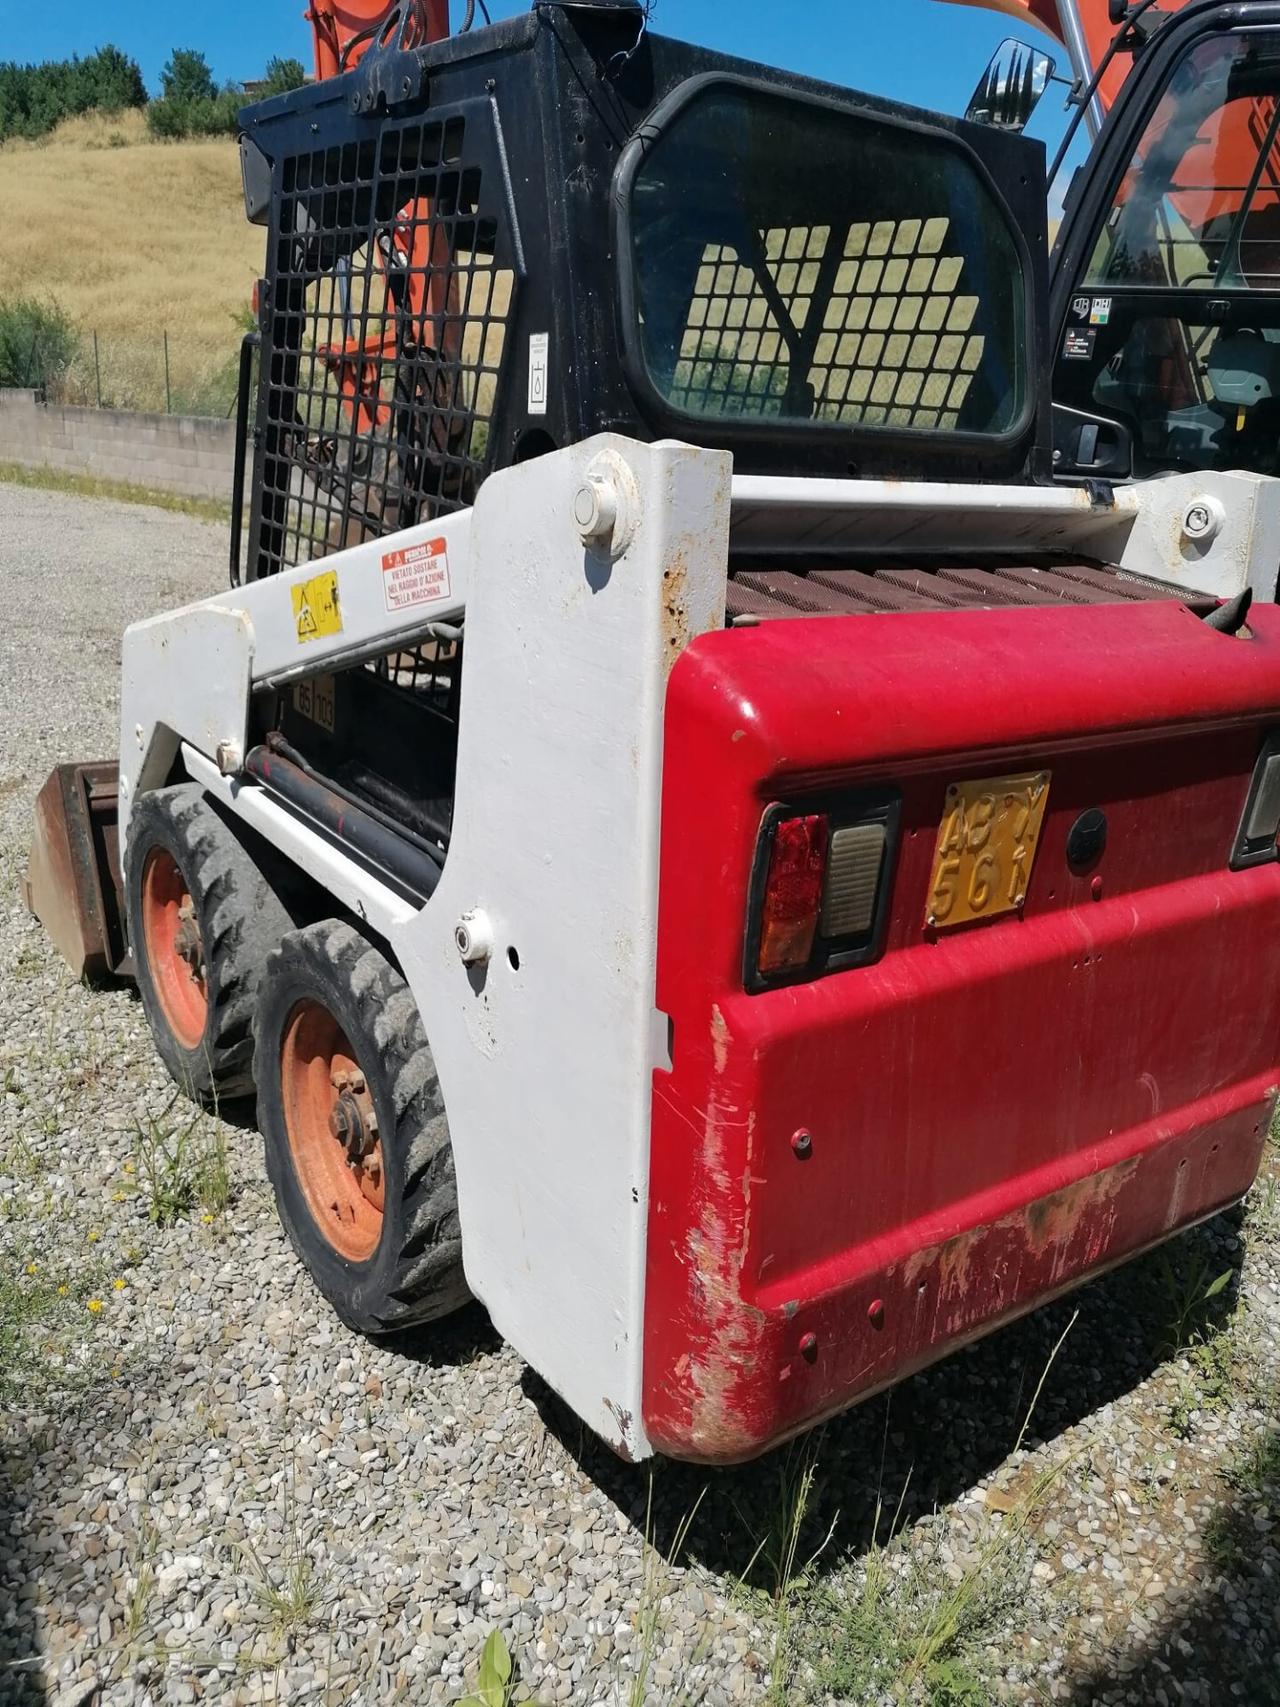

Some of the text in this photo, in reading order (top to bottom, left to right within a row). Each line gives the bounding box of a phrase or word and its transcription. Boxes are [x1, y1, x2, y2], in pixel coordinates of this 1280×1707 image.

[392, 559, 437, 580] VIETATO SOSTARE
[388, 584, 398, 594] NEL
[398, 578, 418, 592] RAGGIO
[394, 585, 441, 606] DELLA MACCHINA
